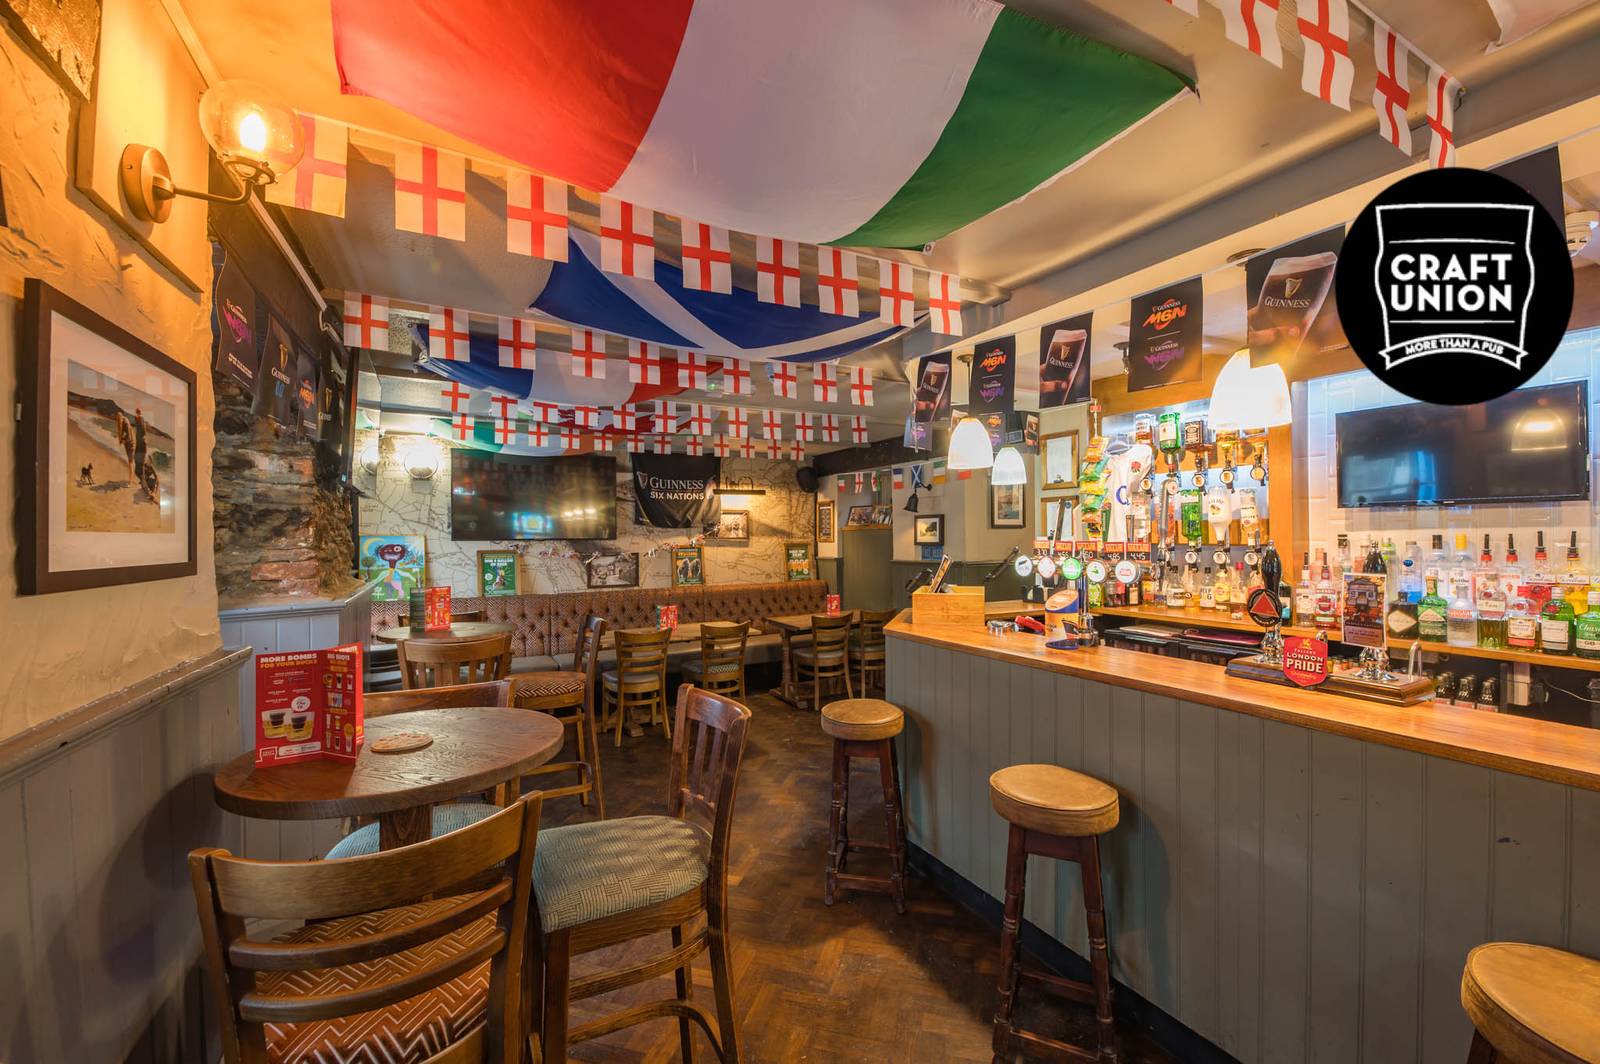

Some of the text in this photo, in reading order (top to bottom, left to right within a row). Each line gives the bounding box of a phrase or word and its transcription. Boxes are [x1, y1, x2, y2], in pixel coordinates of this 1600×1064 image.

[1264, 295, 1311, 309] GUINNESS
[649, 476, 704, 490] GUINNESS
[650, 491, 705, 501] SIX NATIONS
[260, 653, 317, 664] MORE BOMBS
[1286, 652, 1324, 663] LONDON
[275, 660, 295, 668] YOUR
[1286, 658, 1324, 674] PRIDE
